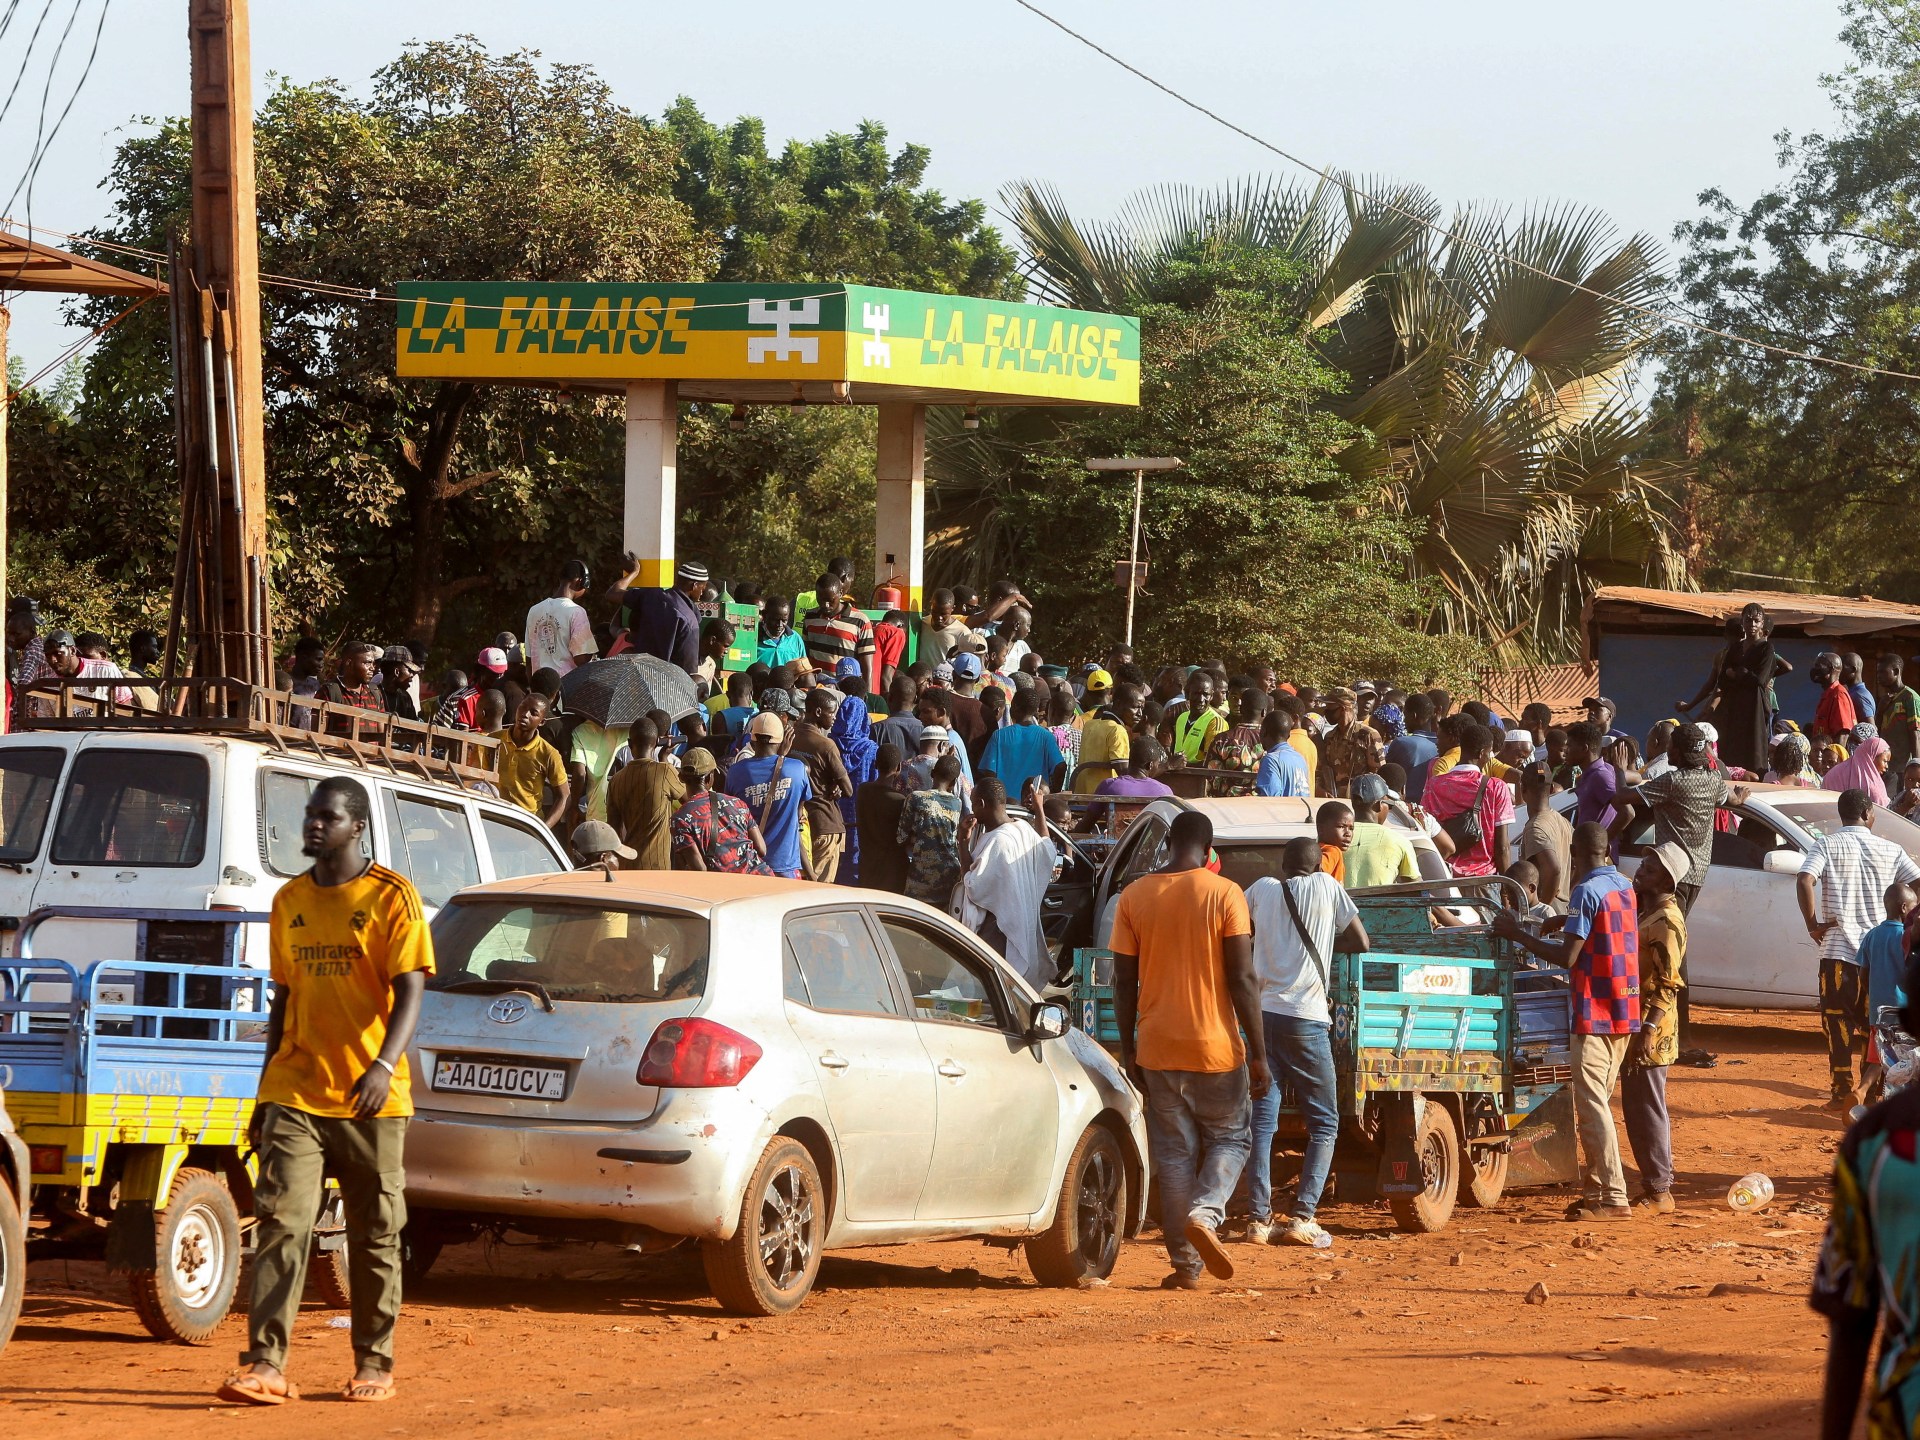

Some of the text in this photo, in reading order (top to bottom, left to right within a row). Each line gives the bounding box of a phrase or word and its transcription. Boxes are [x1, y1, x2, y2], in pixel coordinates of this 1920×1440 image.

[407, 296, 695, 355] LA FALAISE
[920, 308, 1122, 382] LA FALAISE
[112, 1069, 183, 1095] XINGDA
[449, 1063, 549, 1094] AA010CV
